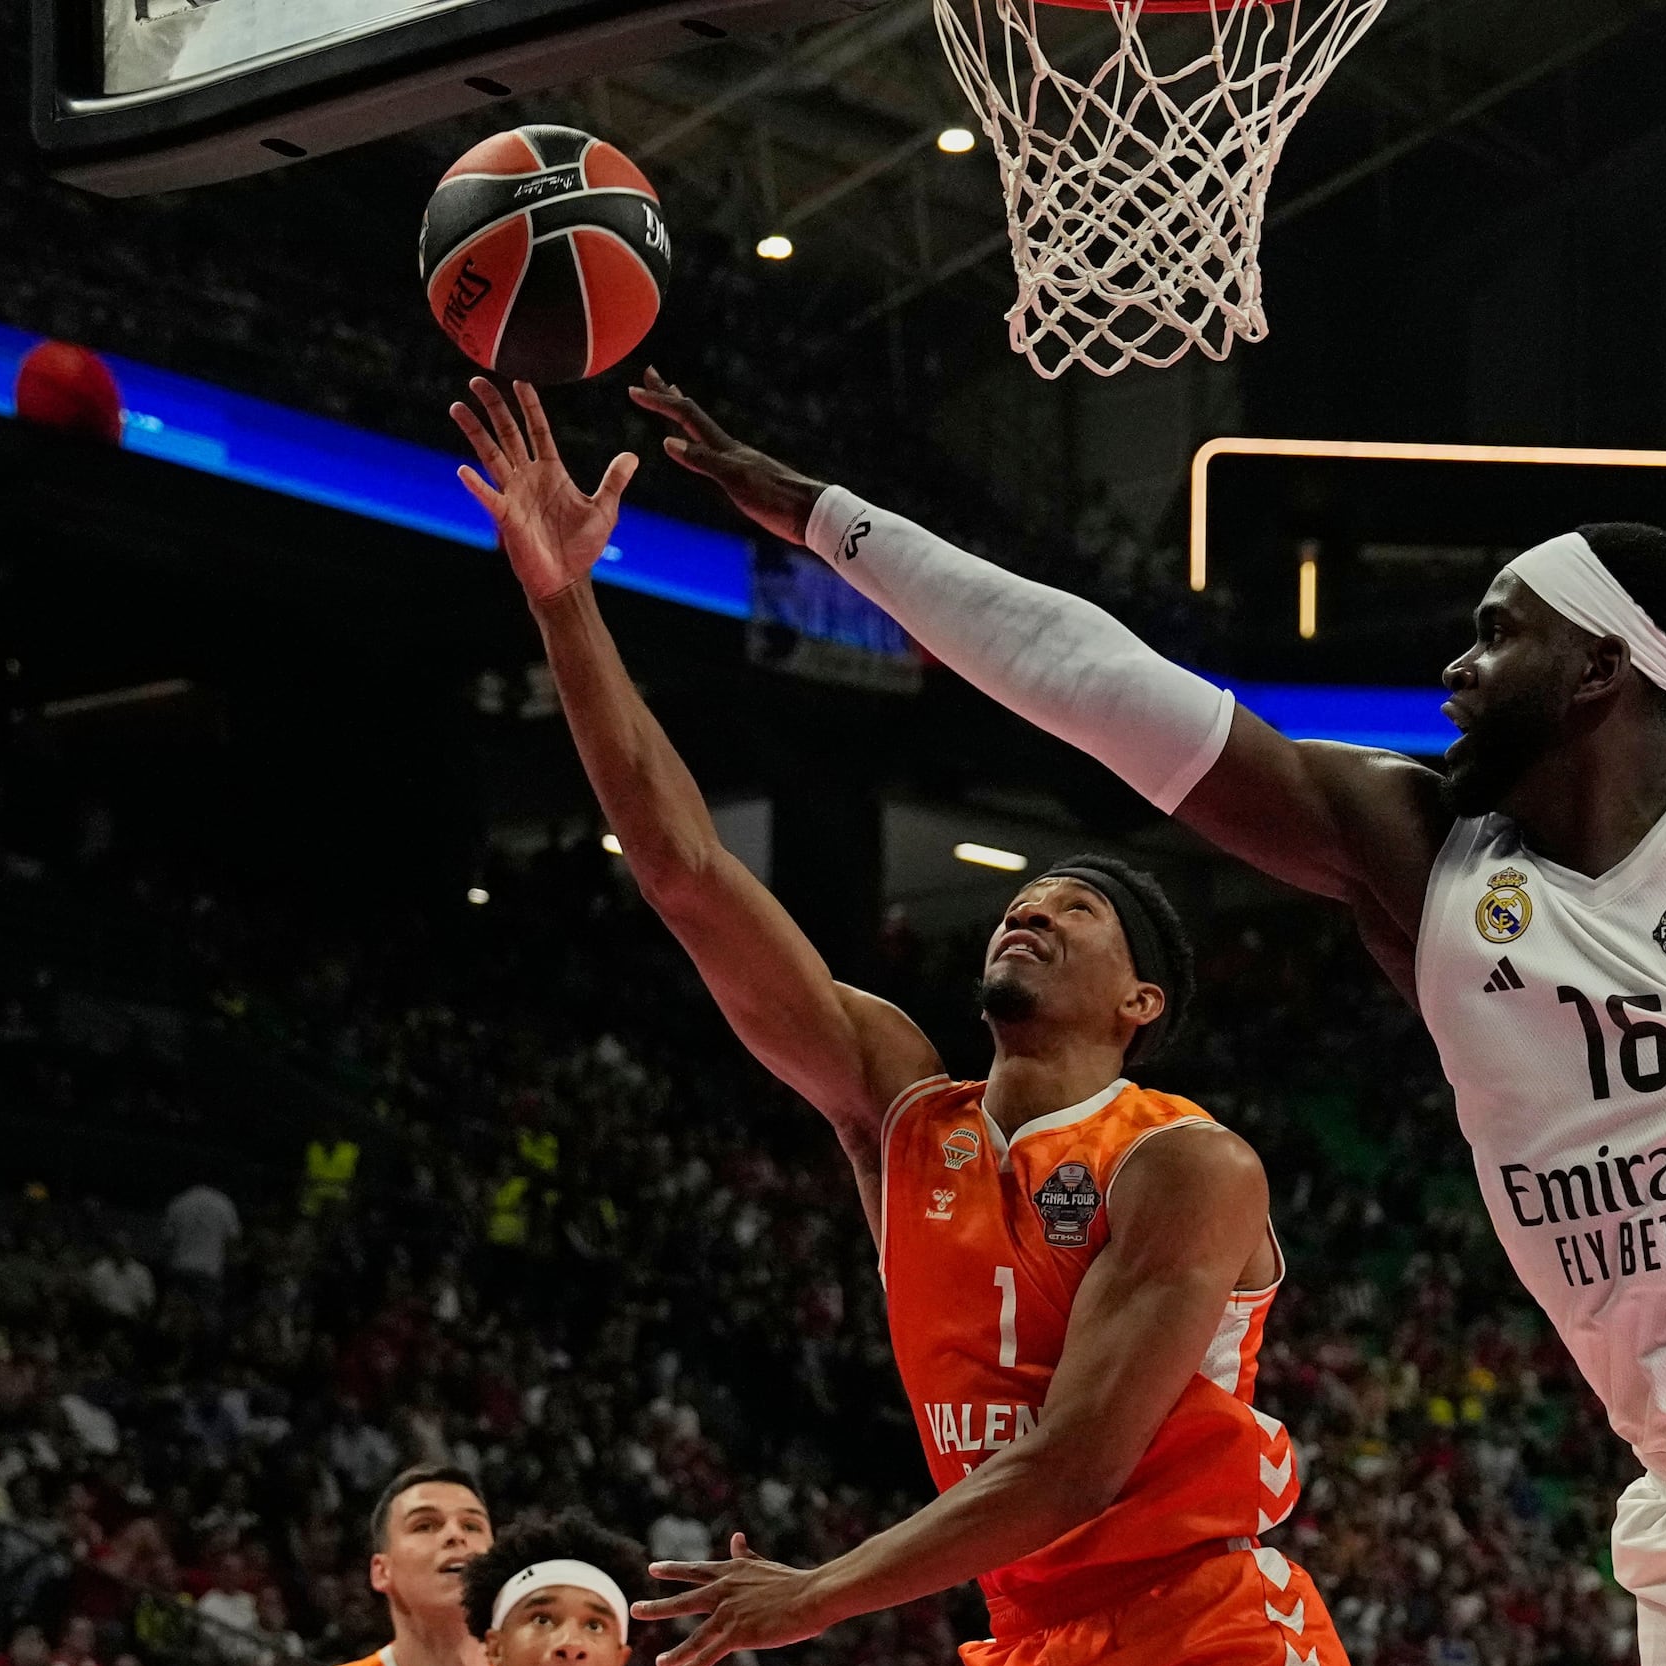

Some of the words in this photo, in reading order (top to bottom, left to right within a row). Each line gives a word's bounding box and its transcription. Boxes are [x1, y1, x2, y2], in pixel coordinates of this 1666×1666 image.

[1041, 1192, 1070, 1205] FINAL
[1071, 1193, 1095, 1206] FOUR
[1555, 1229, 1608, 1287] FLY
[994, 1265, 1017, 1368] 1
[924, 1402, 1046, 1455] VALEN
